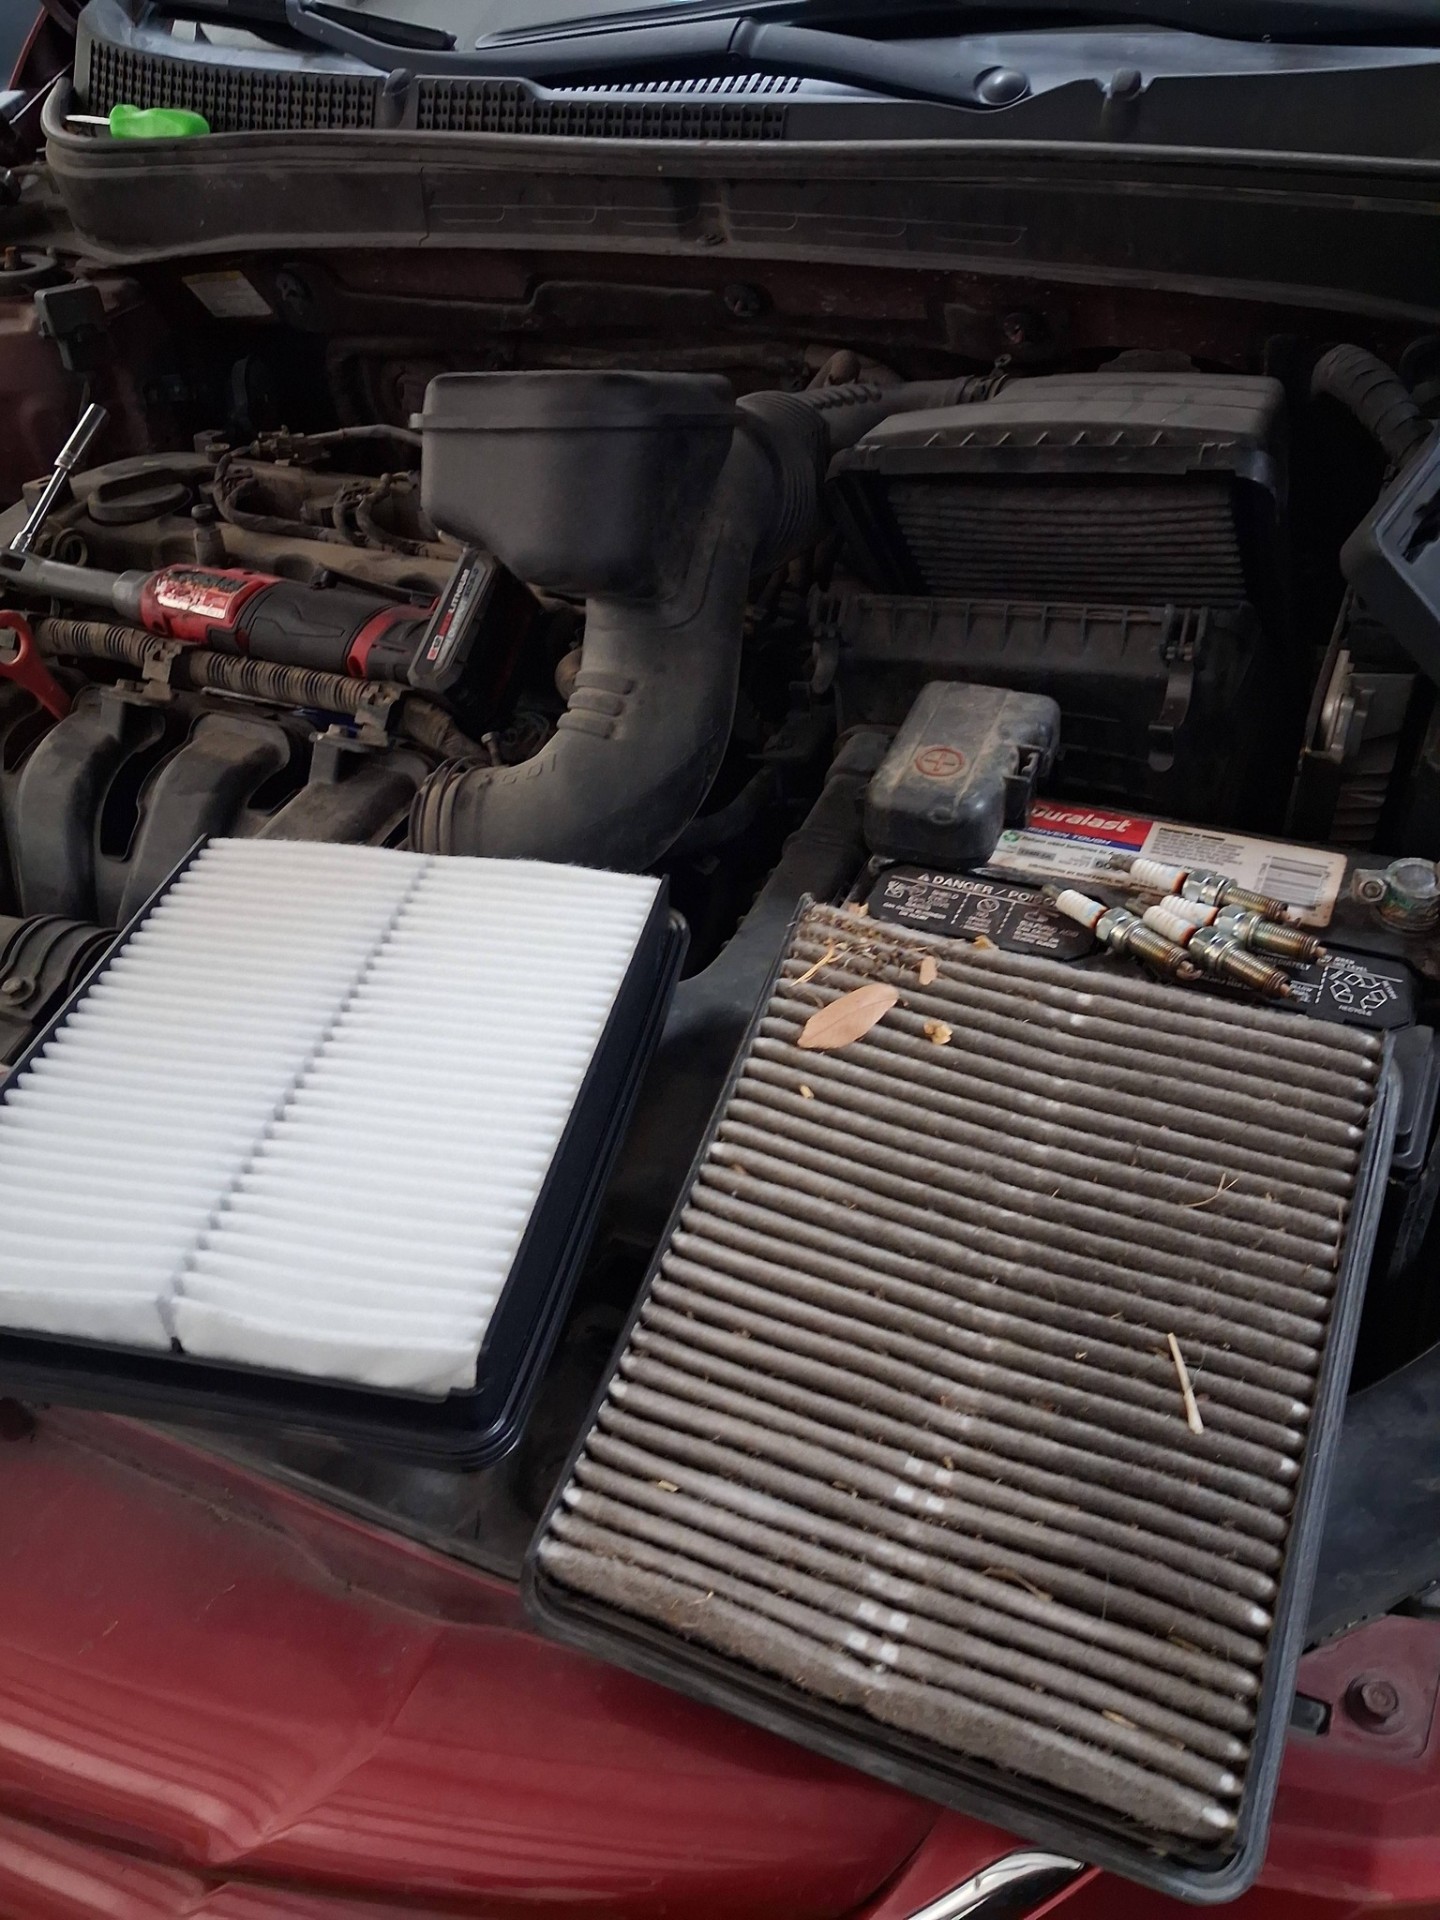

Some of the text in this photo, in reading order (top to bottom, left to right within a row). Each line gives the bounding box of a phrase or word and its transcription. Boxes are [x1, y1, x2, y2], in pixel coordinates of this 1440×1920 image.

[1030, 806, 1132, 833] Duralast
[1072, 834, 1111, 846] TOUGH
[932, 875, 994, 895] DANGER
[1008, 890, 1056, 906] POISO
